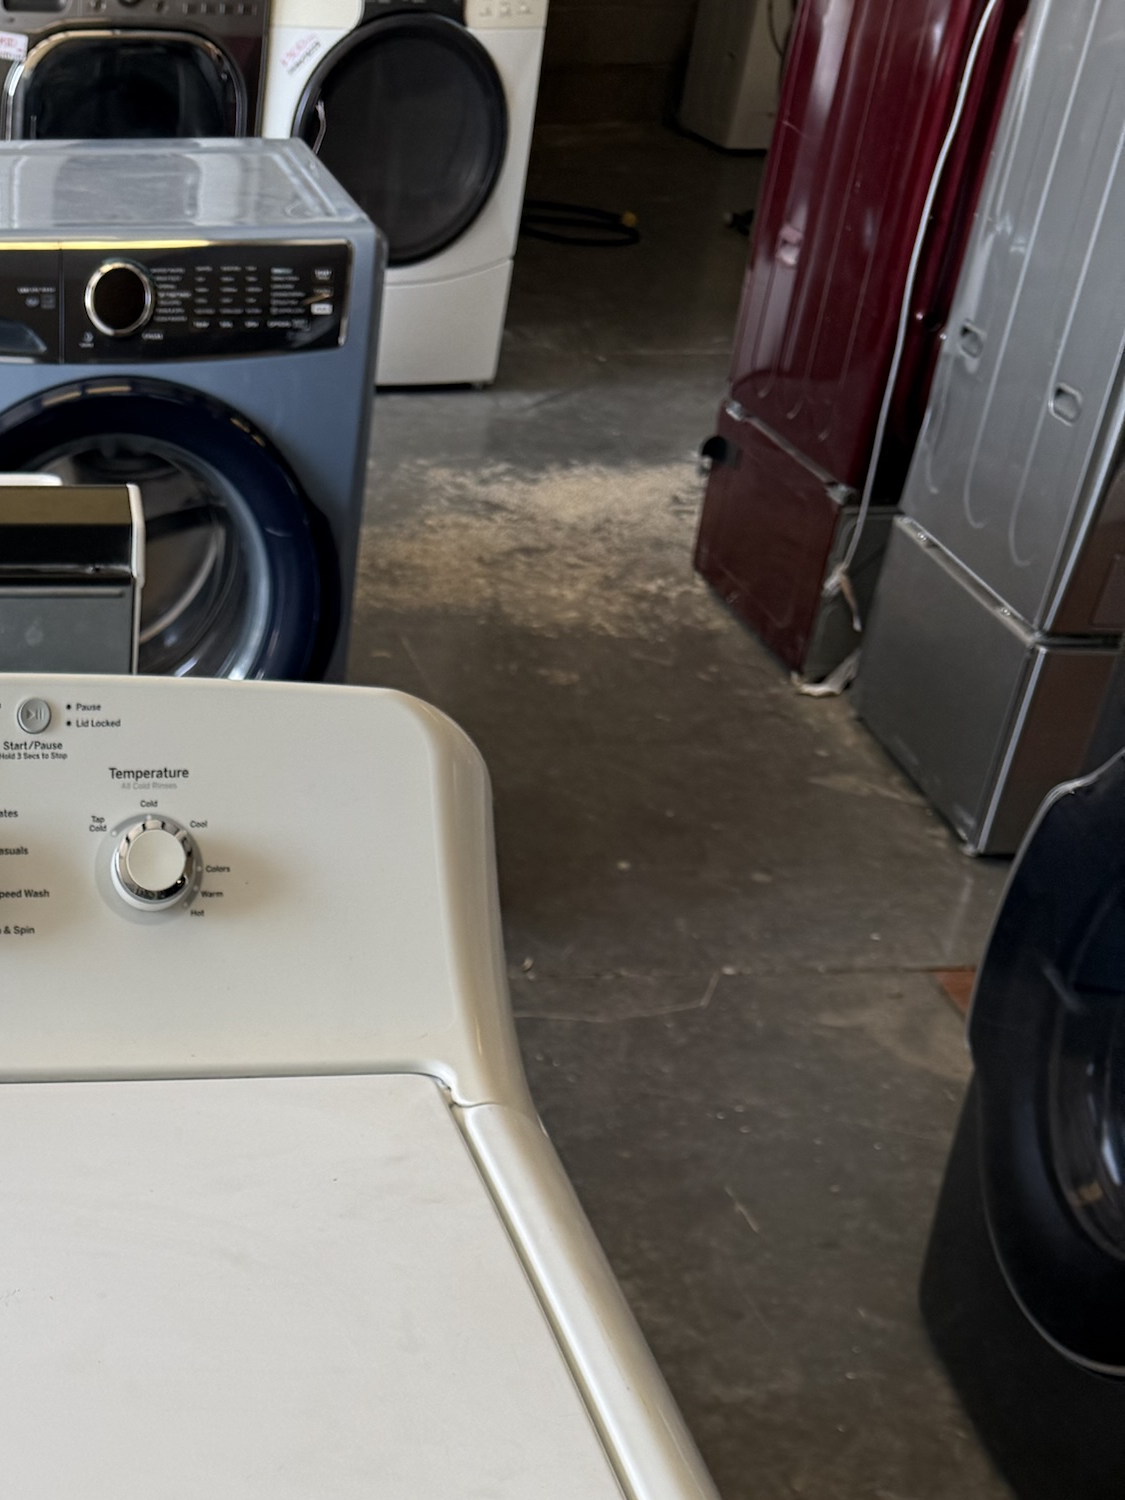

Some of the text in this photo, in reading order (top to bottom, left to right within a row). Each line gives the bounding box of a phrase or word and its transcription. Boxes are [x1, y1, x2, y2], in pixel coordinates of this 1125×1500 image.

[76, 703, 102, 711] Pause
[76, 719, 121, 728] Lid Locked
[3, 741, 63, 751] Start/Pause
[17, 752, 22, 760] 3
[23, 752, 41, 760] Secs
[42, 752, 49, 760] to
[50, 752, 68, 761] Stop
[109, 767, 190, 780] Temperature
[140, 800, 158, 808] Cold
[91, 815, 105, 825] Tap
[190, 820, 208, 829] Cool
[89, 824, 107, 832] Cold
[206, 865, 230, 874] Colors
[24, 889, 50, 898] Wash
[201, 890, 223, 898] Warm
[190, 909, 205, 918] Hot
[3, 925, 11, 935] &
[13, 925, 35, 937] Spin
